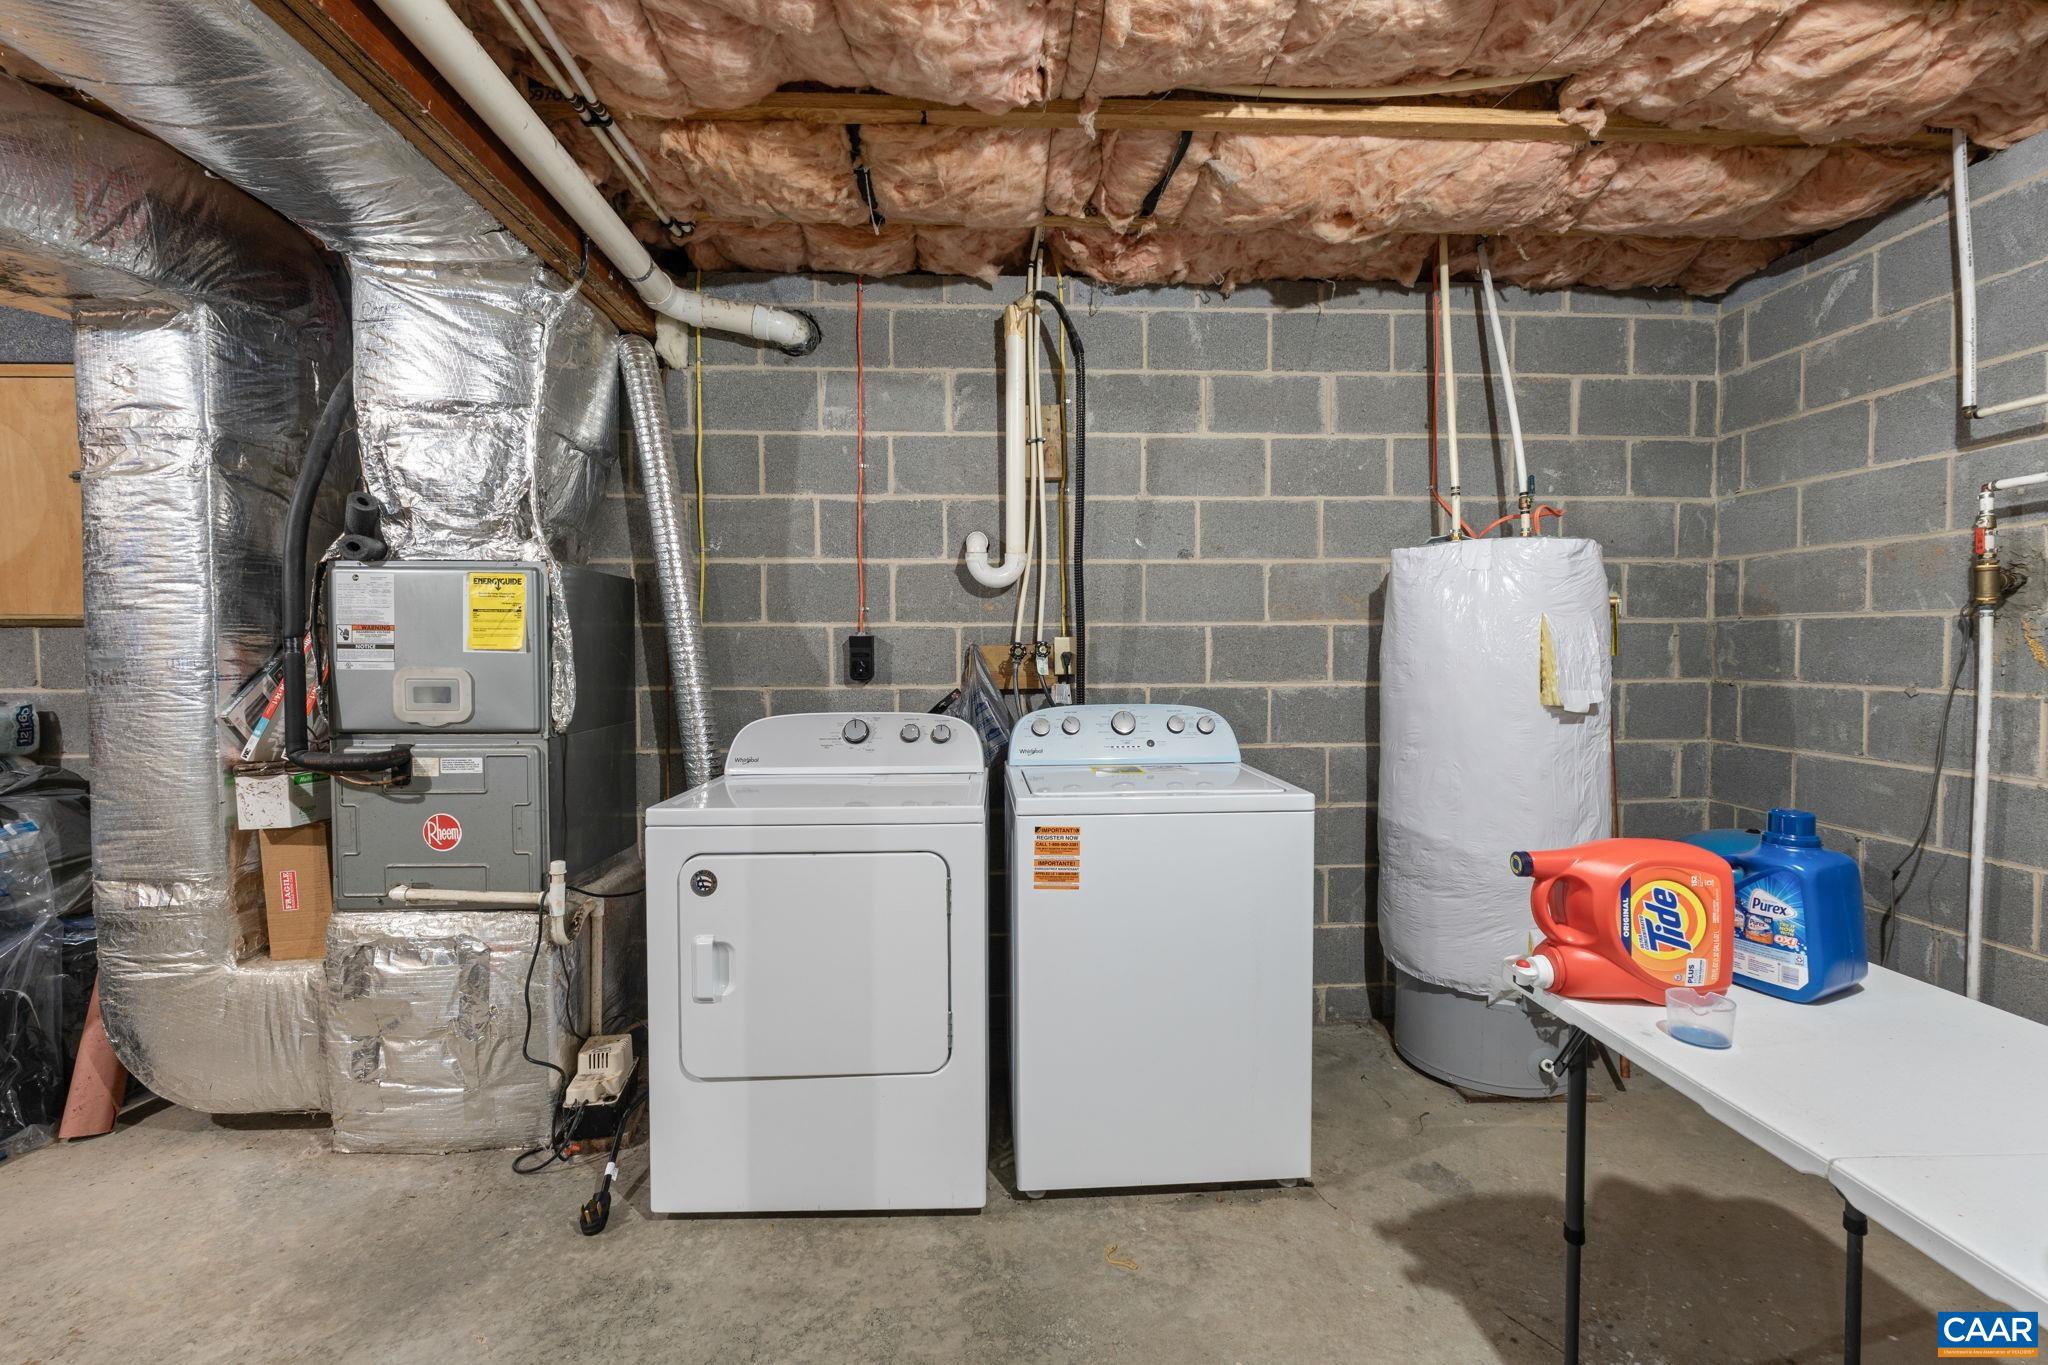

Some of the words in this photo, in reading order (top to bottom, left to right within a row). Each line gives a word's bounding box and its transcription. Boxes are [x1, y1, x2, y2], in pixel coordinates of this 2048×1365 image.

[427, 815, 460, 845] Rheem
[283, 872, 292, 910] FRAGILE
[1752, 897, 1788, 916] Purex
[1622, 897, 1630, 938] ORIGINAL
[1643, 887, 1693, 953] Tide
[1687, 964, 1695, 984] PLUS
